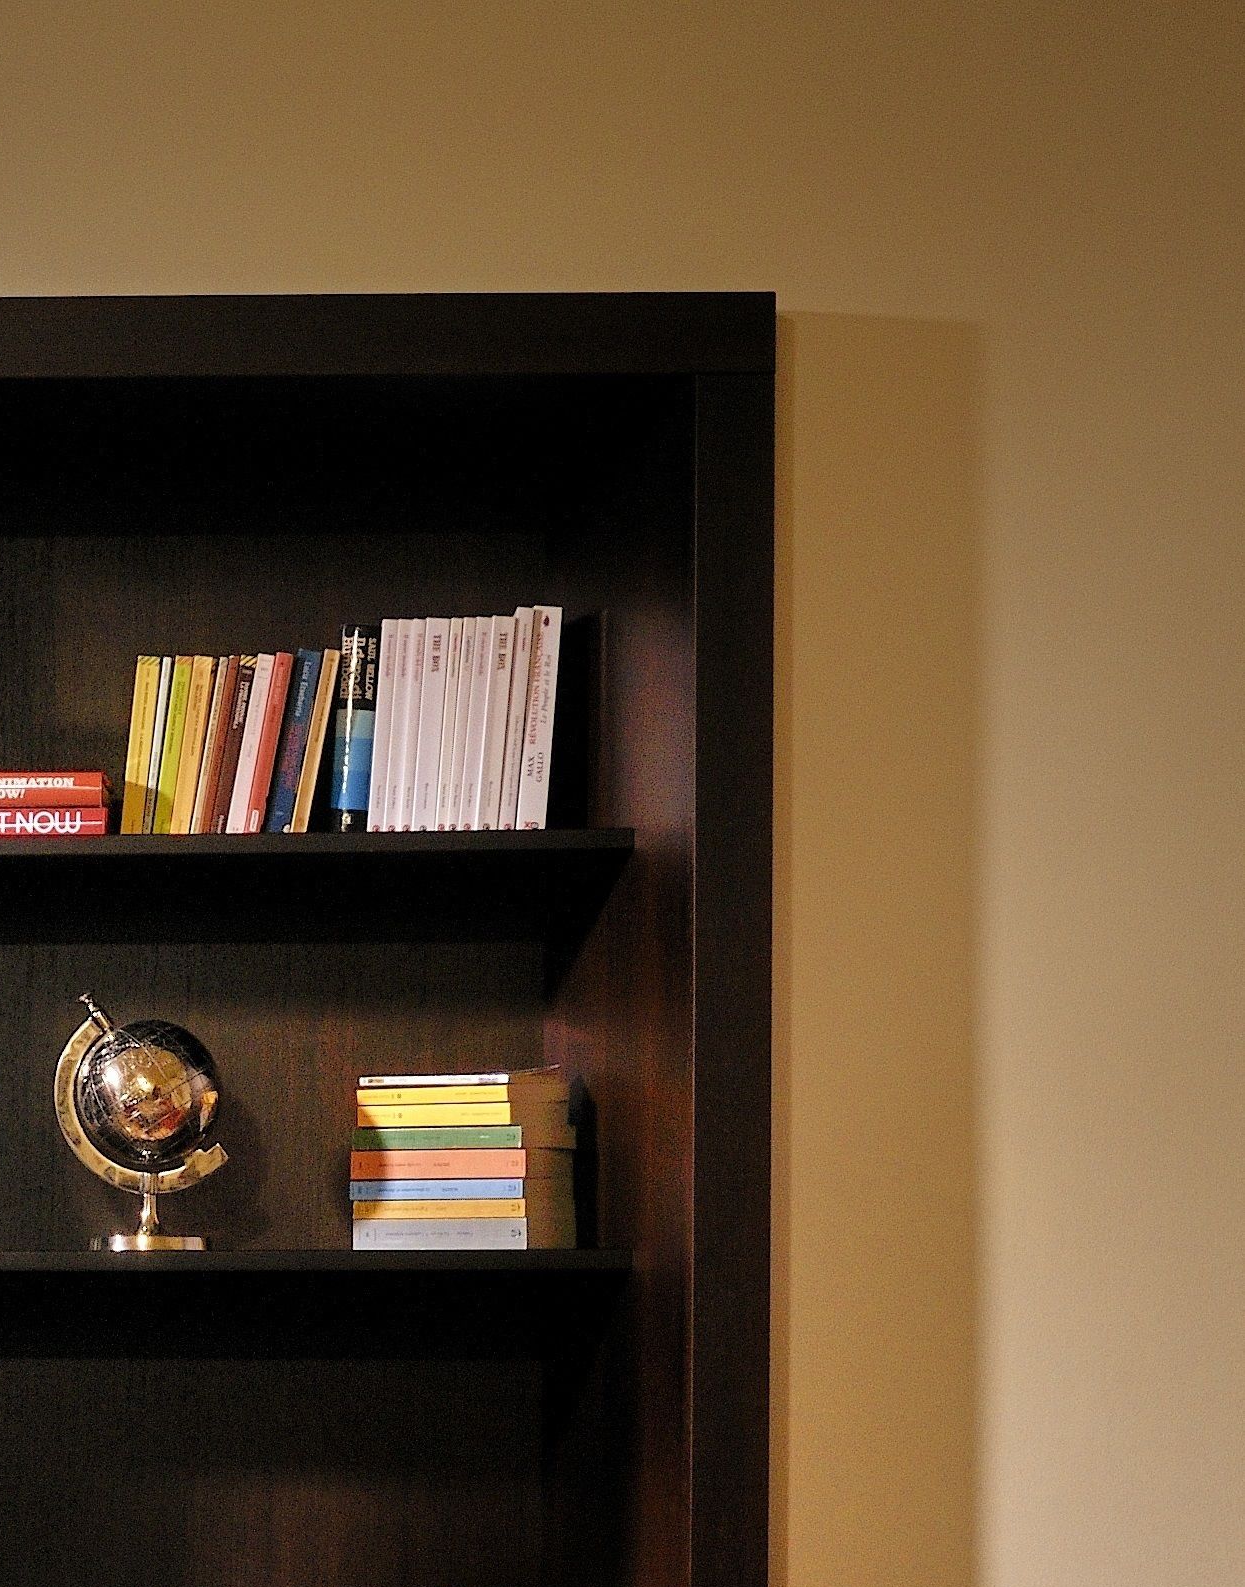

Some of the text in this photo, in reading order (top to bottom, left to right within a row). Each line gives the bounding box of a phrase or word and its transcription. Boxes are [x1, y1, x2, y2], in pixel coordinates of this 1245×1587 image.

[431, 634, 442, 673] THE BOX
[497, 632, 508, 670] THE BOX
[365, 638, 377, 700] SAUL BELLOW
[527, 756, 535, 777] MAX
[535, 752, 544, 783] GALLO
[16, 811, 82, 834] NOW
